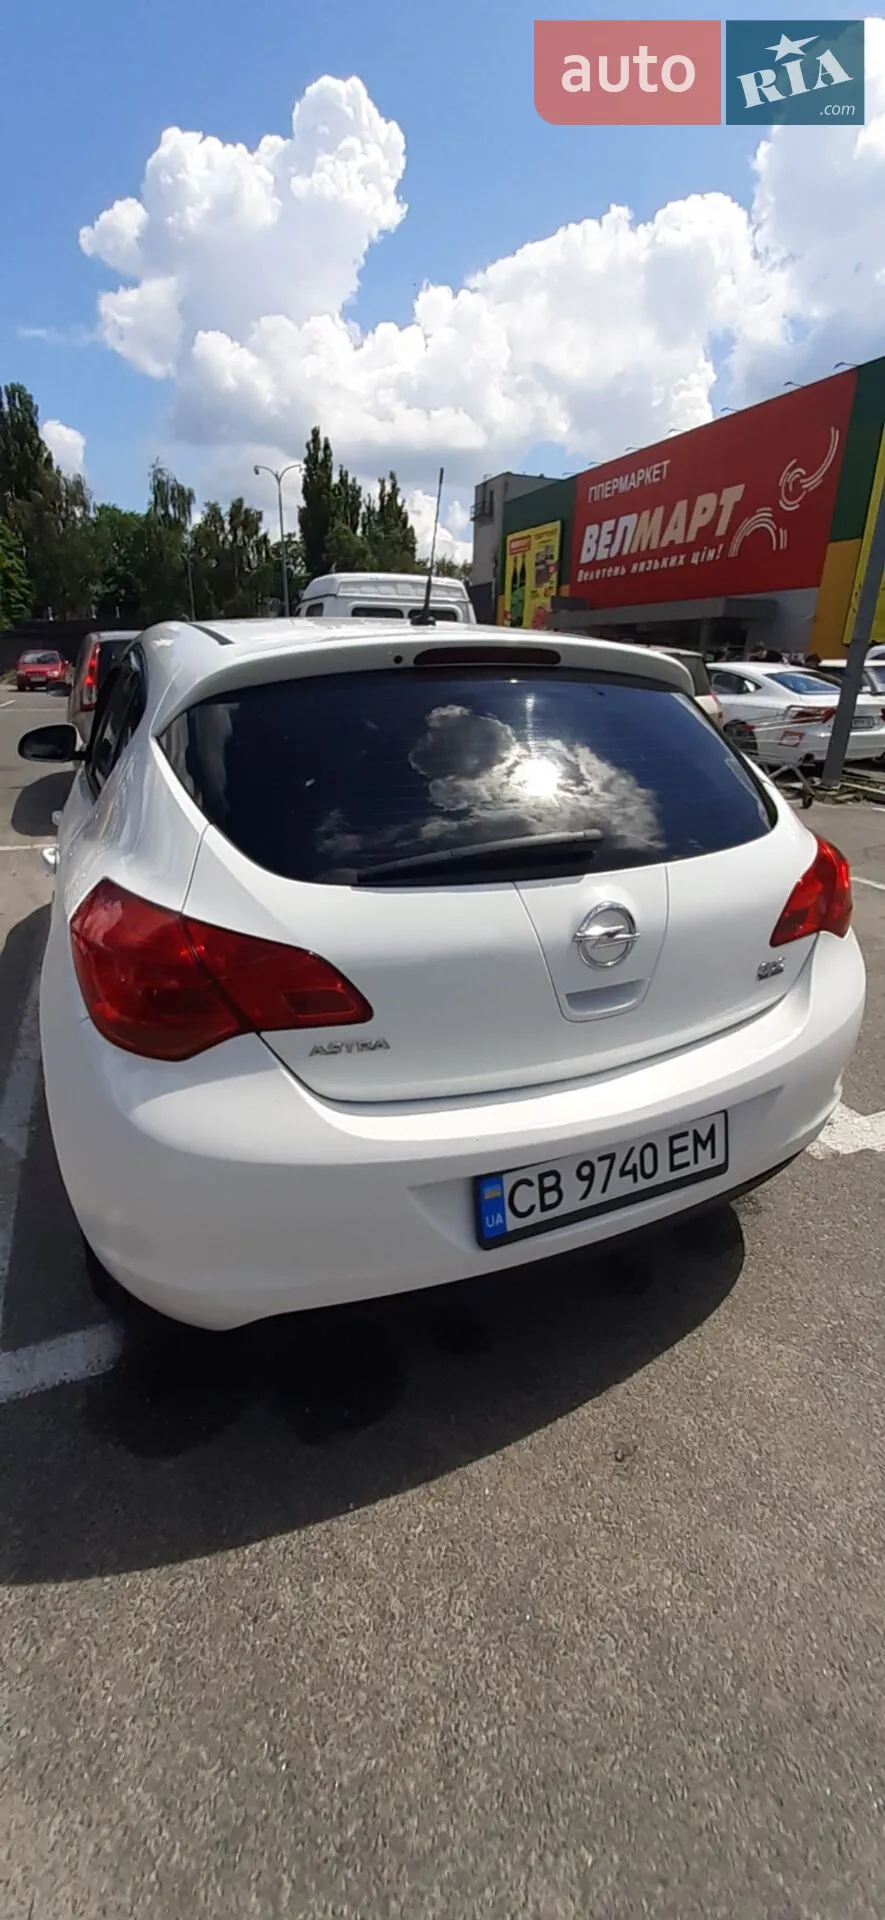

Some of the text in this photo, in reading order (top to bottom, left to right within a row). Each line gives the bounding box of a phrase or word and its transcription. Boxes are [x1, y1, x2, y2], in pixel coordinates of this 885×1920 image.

[588, 459, 671, 503] ГІПЕРМАРКЕТ
[579, 484, 745, 564] ВЕЛМАРТ
[577, 544, 724, 582] Велетень низьких цін!
[309, 1037, 391, 1057] ASTRA
[508, 1123, 717, 1219] CB 9740 EM
[486, 1215, 504, 1228] UA
